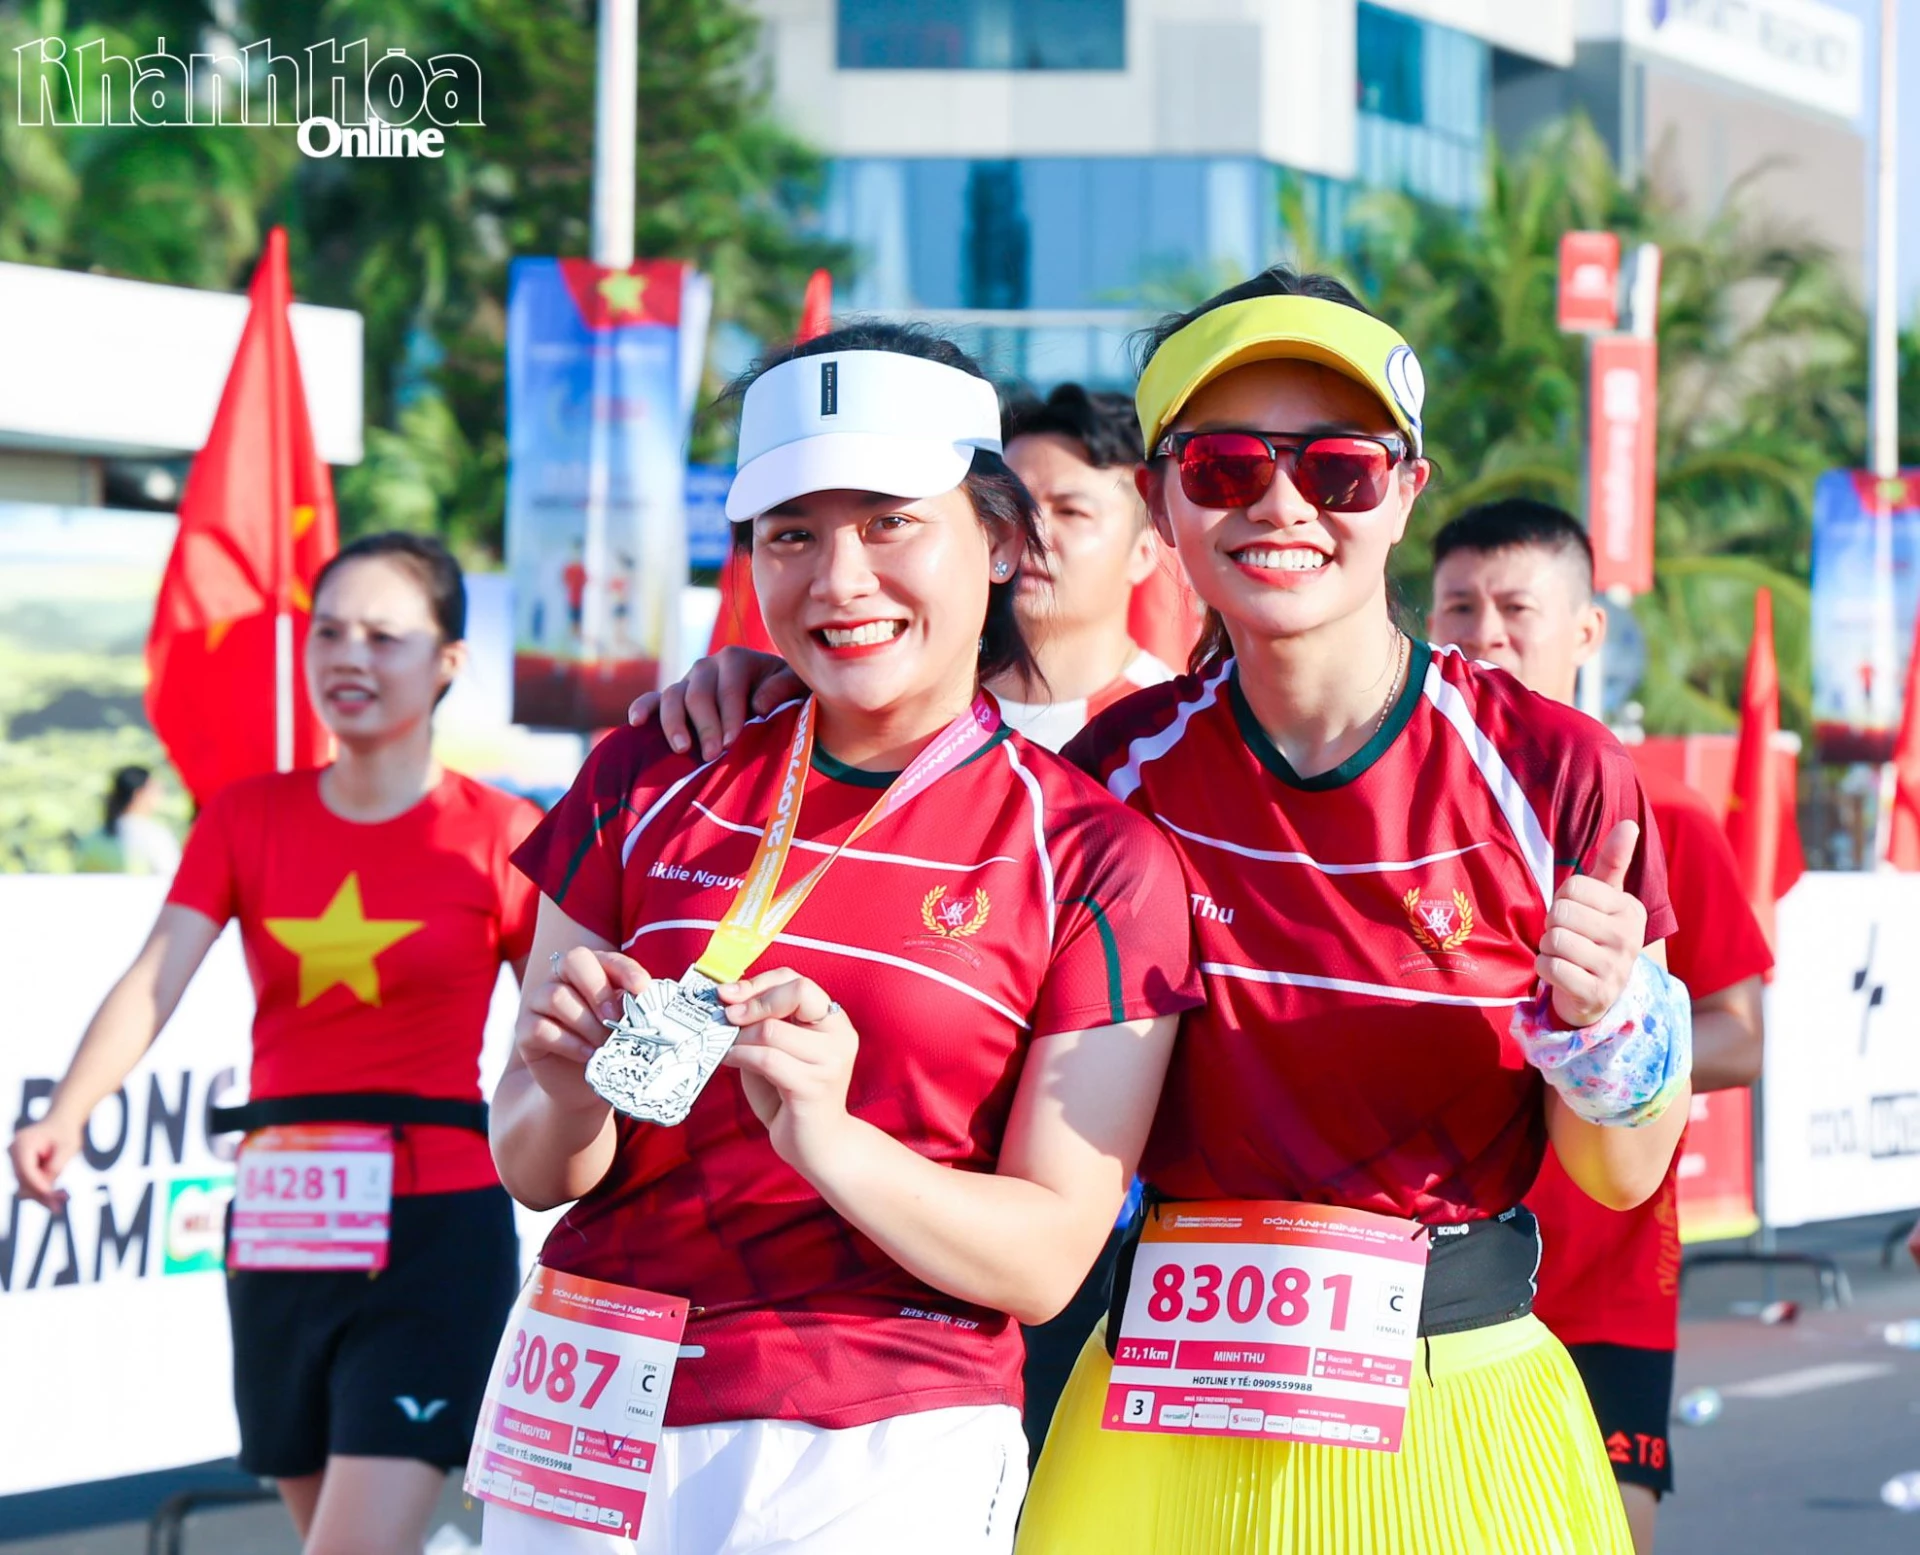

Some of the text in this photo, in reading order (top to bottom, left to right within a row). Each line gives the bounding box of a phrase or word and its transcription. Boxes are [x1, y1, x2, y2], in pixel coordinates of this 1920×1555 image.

[647, 862, 690, 880] ikkie
[1190, 893, 1234, 924] Thu
[1295, 1217, 1327, 1229] ÁNH
[1365, 1229, 1405, 1242] MINH
[1147, 1264, 1353, 1331] 83081
[1390, 1285, 1405, 1293] PEN
[627, 1305, 663, 1319] MINH
[1389, 1295, 1404, 1312] C
[1376, 1325, 1406, 1336] FEMALE
[1121, 1346, 1169, 1361] 21,1km
[1213, 1351, 1266, 1364] MINH THU
[505, 1328, 621, 1410] 3087
[643, 1364, 657, 1372] PEN
[642, 1374, 655, 1393] C
[1192, 1374, 1313, 1392] HOTLINE Y TẾ: 0909559988
[628, 1406, 654, 1418] FEMALE
[1132, 1399, 1144, 1416] 3
[520, 1423, 551, 1441] NGUYEN
[1634, 1433, 1666, 1470] T8
[530, 1453, 573, 1471] 0909559988
